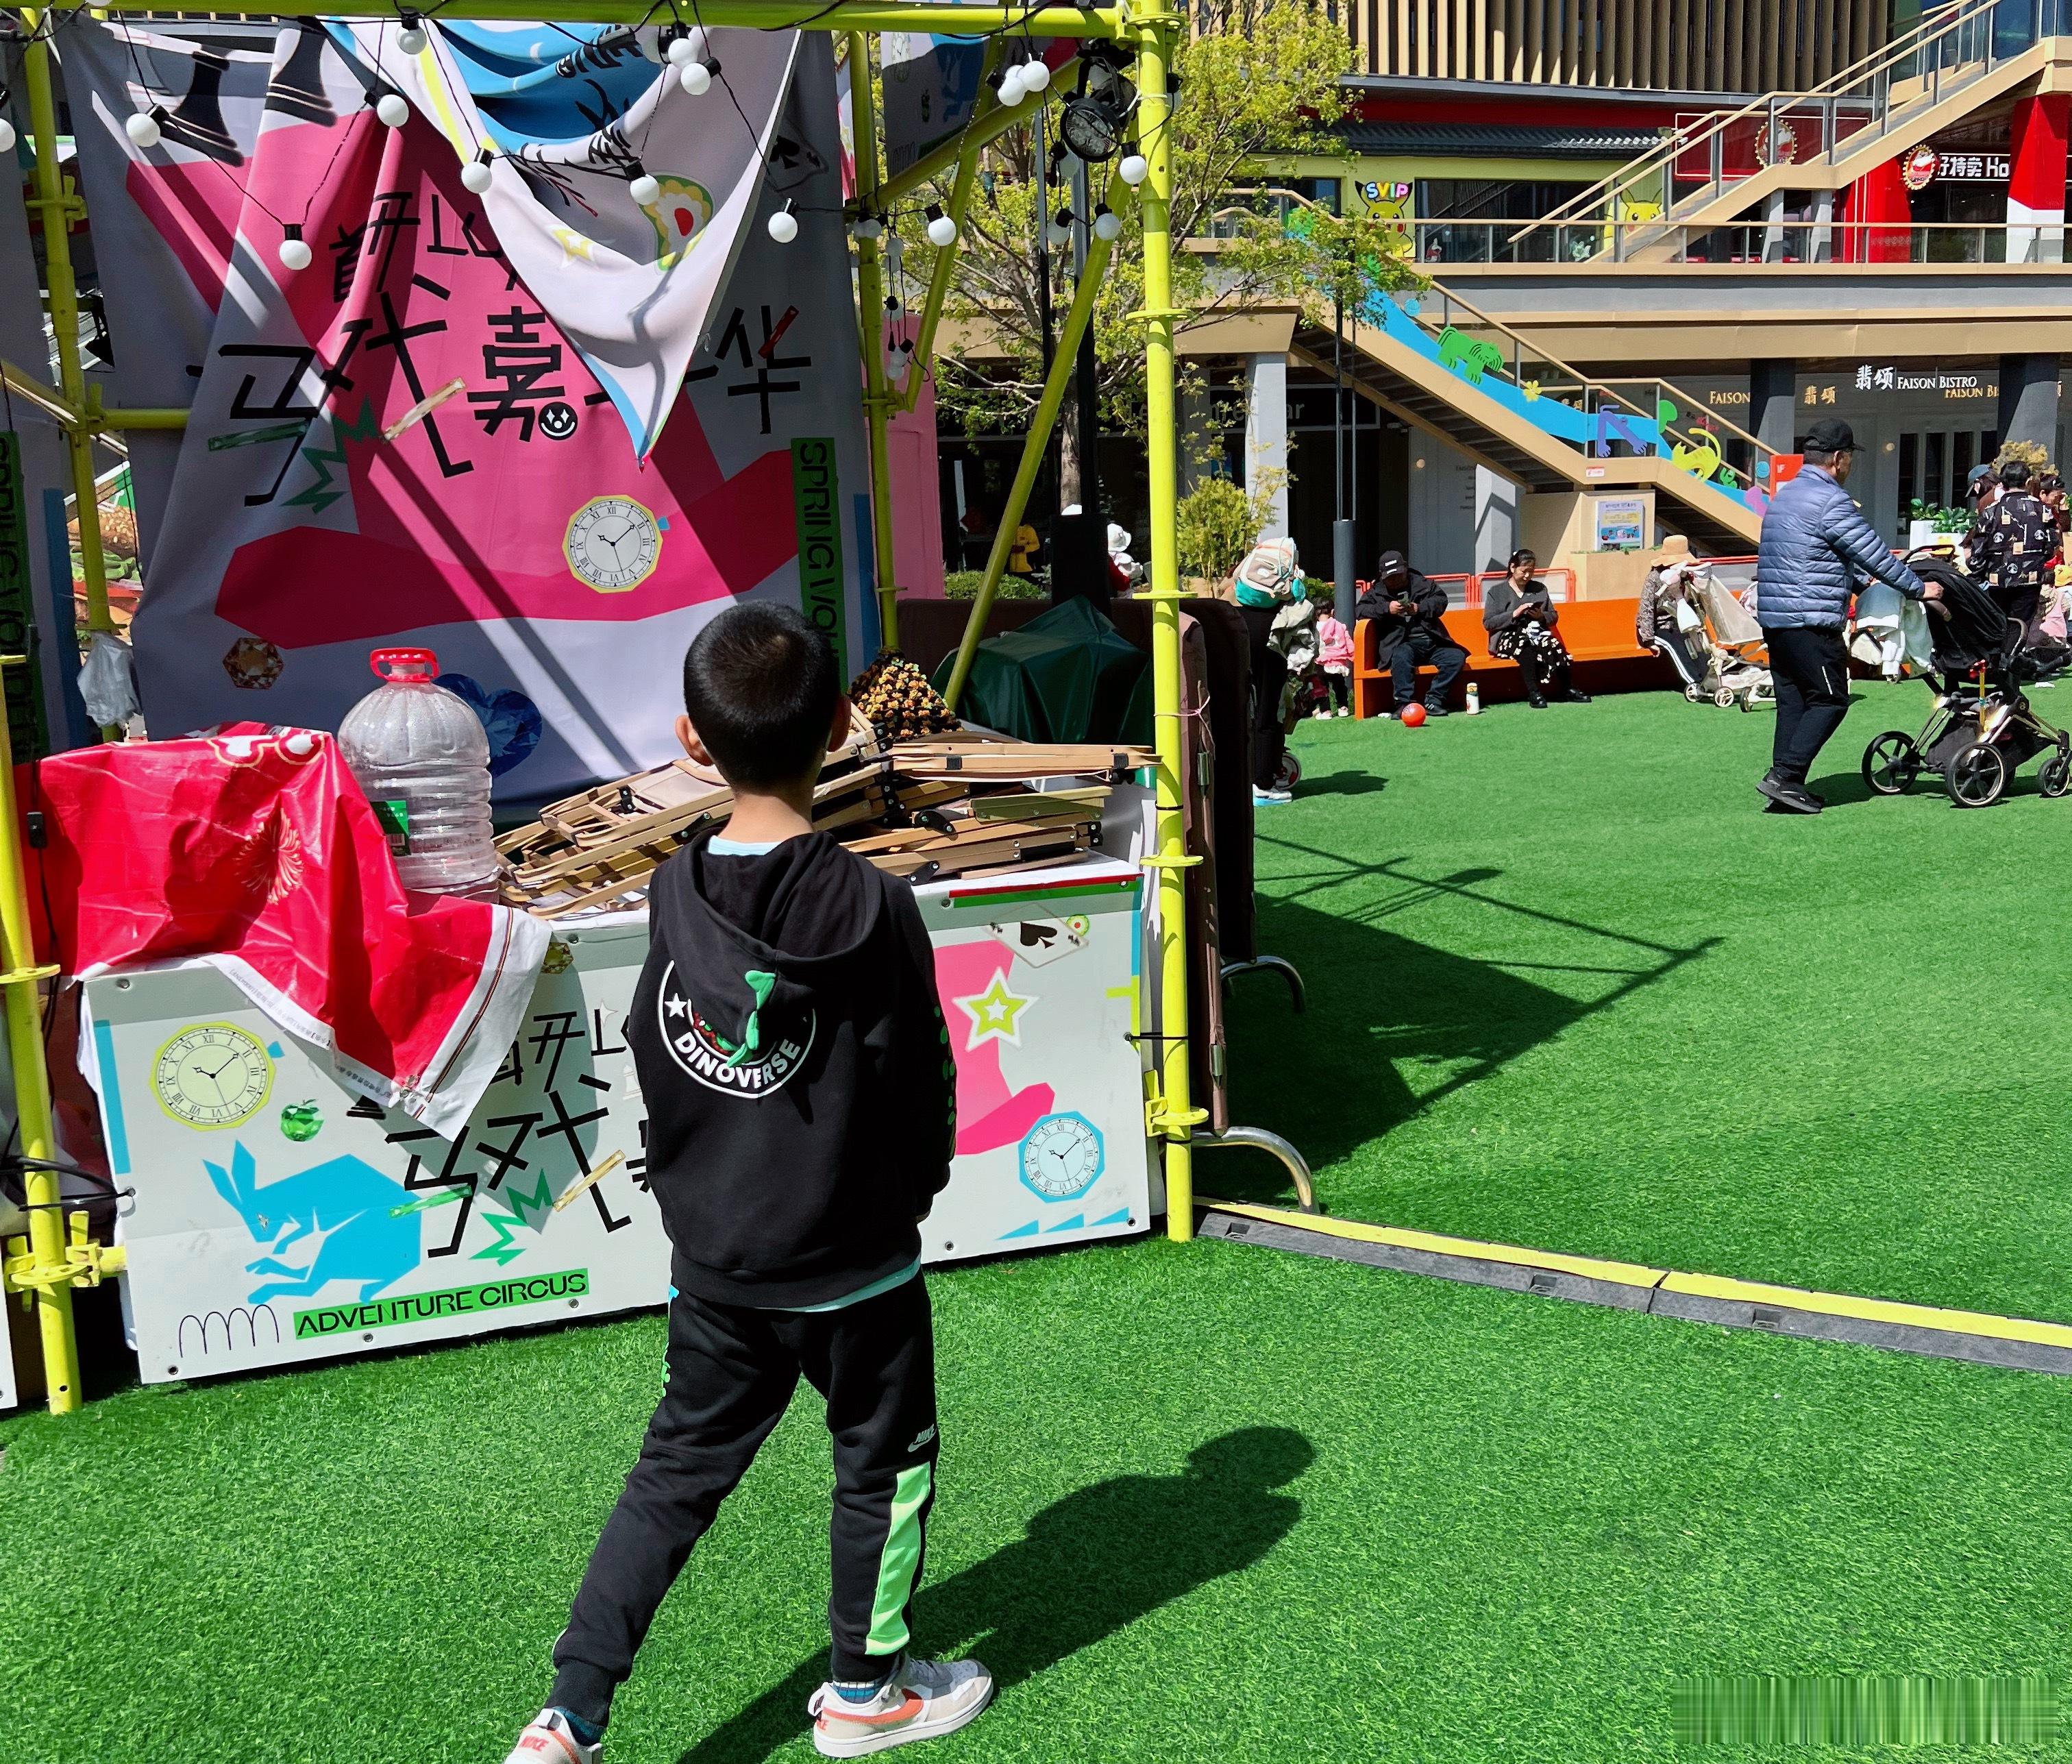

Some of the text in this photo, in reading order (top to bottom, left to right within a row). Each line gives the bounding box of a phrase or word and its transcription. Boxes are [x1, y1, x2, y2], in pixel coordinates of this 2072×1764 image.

[1366, 182, 1409, 200] SVIP
[1710, 391, 1751, 404] FAISON
[1897, 377, 1936, 389] FAISON
[1939, 376, 1977, 389] BISTRO
[800, 441, 835, 570] SPRING
[674, 1031, 800, 1089] DINOVERSE
[297, 1273, 587, 1336] ADVENTURE CIRCUS
